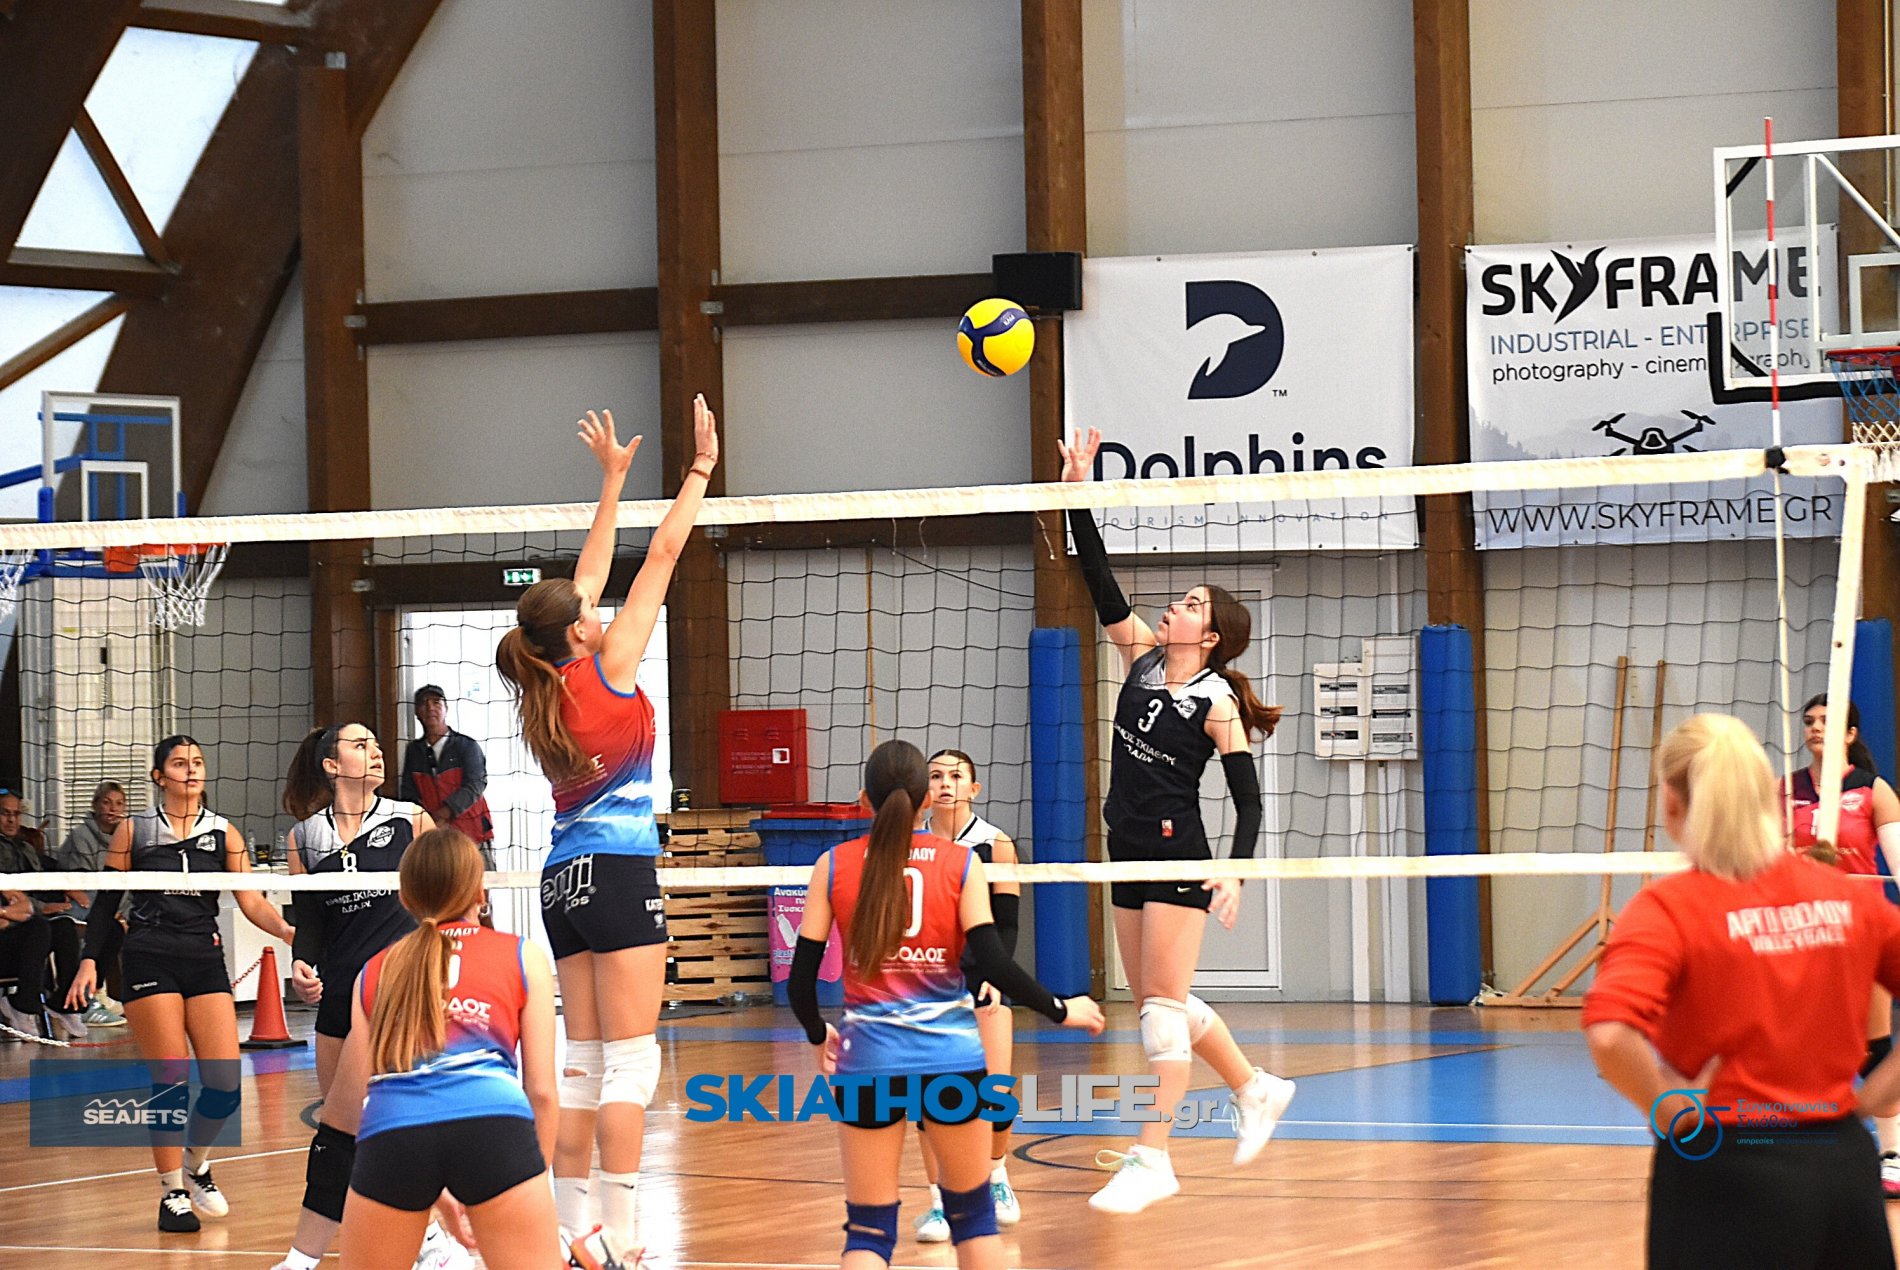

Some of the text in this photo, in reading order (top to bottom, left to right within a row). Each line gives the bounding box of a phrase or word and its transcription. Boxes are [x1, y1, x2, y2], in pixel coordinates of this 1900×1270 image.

[1491, 328, 1638, 355] INDUSTRIAL
[1493, 358, 1624, 385] photography
[1095, 511, 1389, 527] TOURISM INNOVATION
[1488, 496, 1832, 534] WWW.SKYFRAMEGR
[1137, 698, 1164, 733] 3
